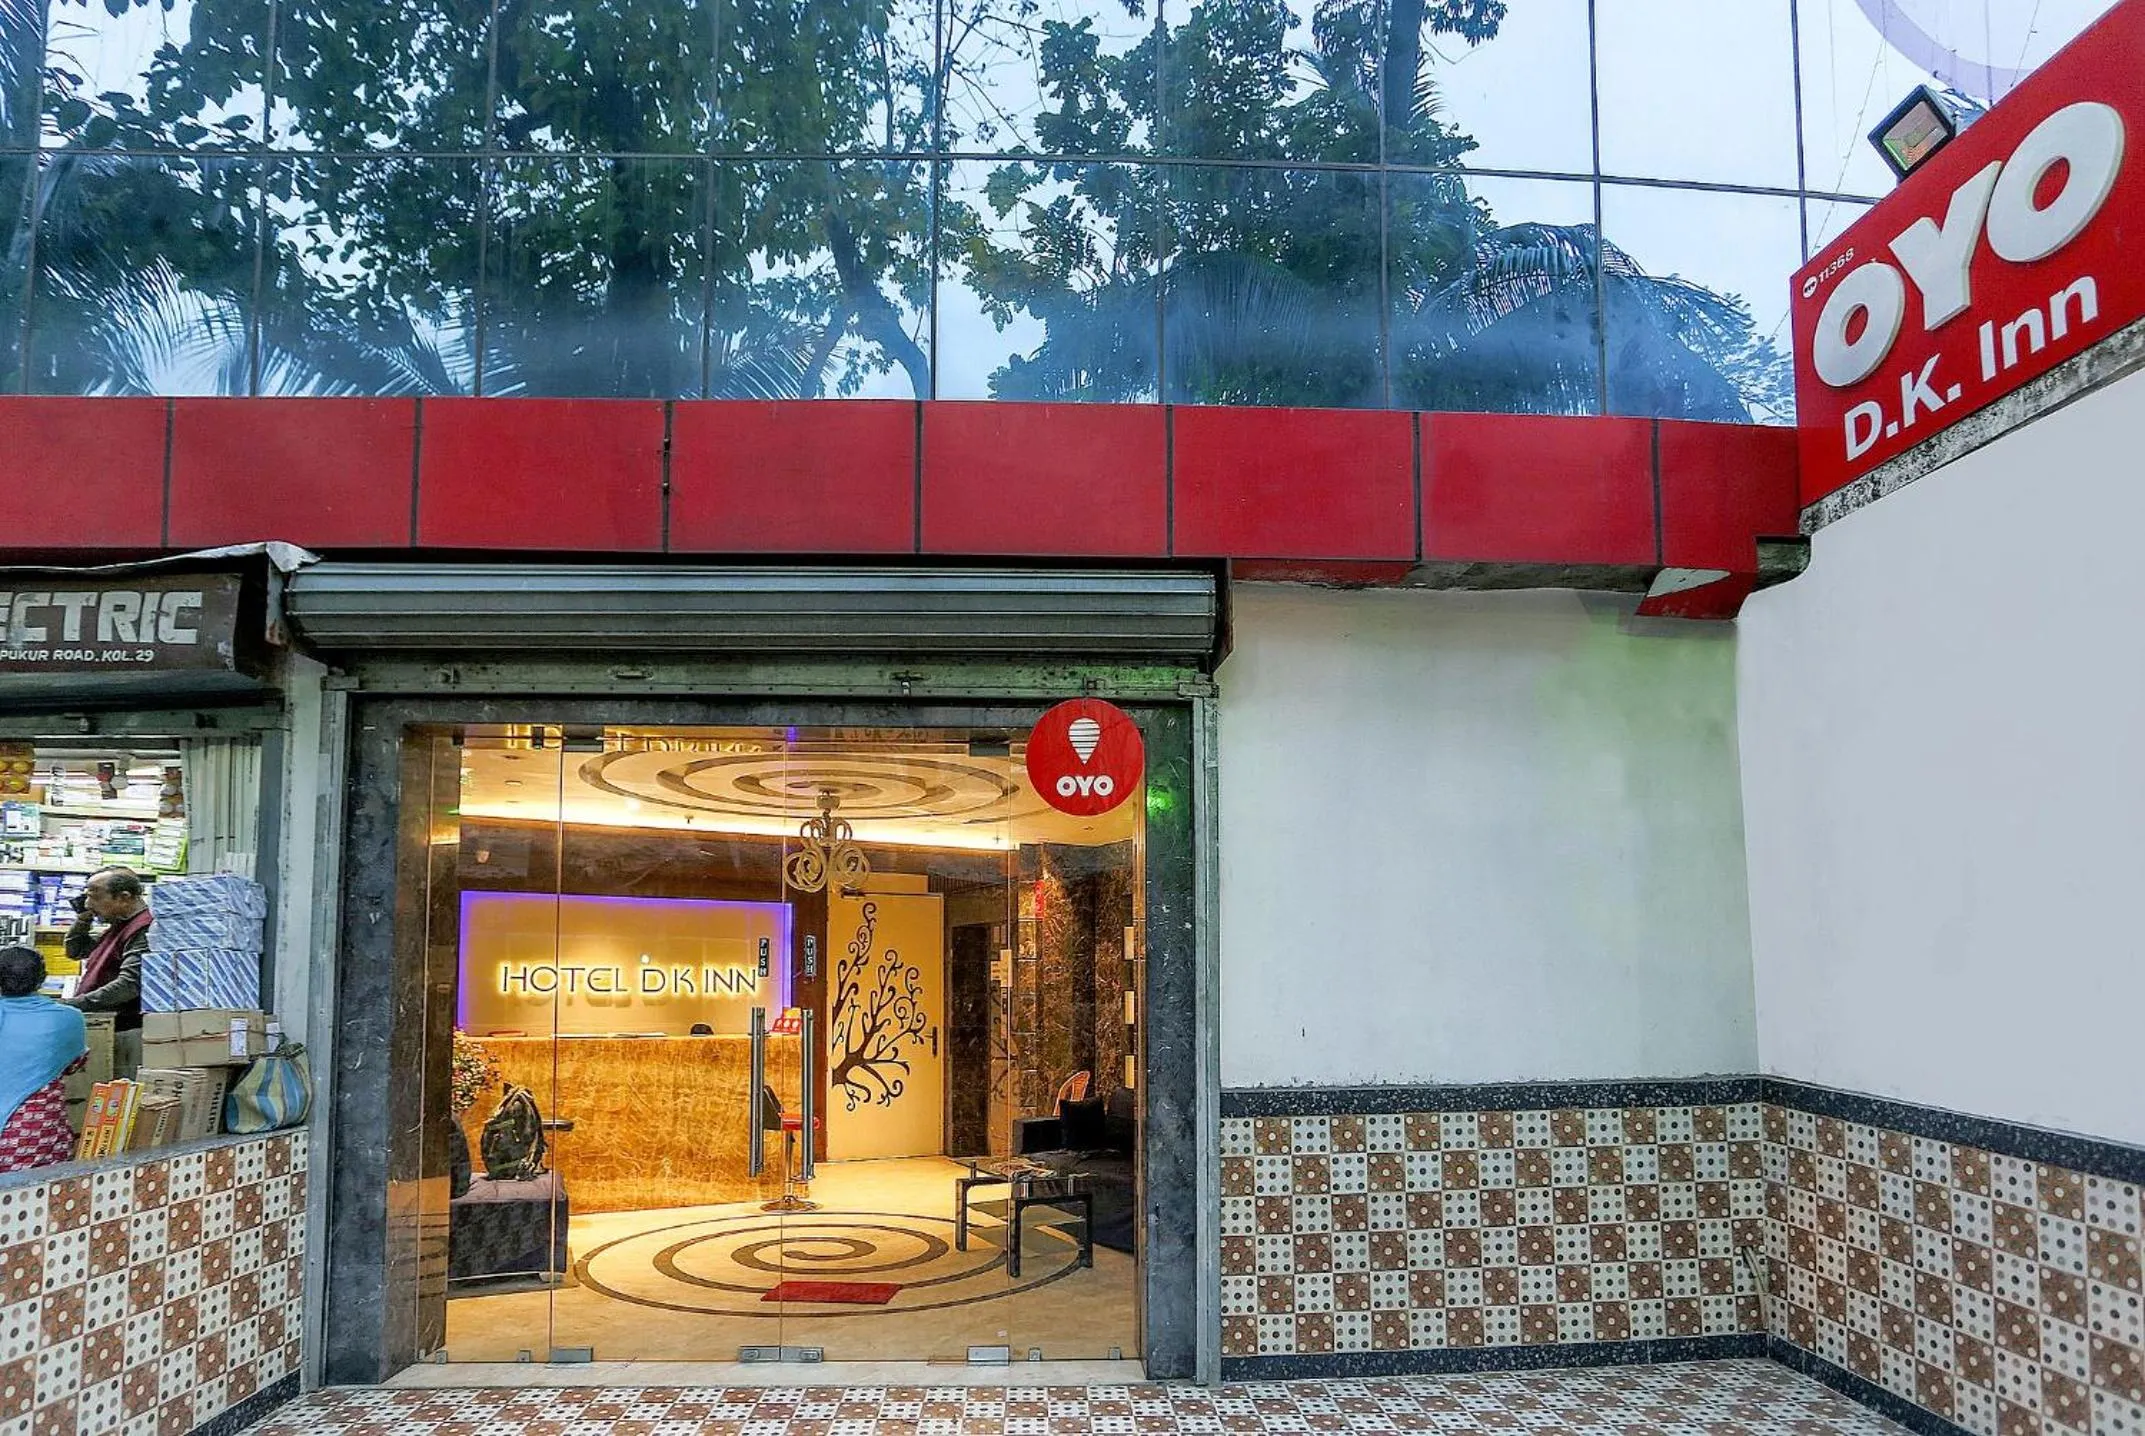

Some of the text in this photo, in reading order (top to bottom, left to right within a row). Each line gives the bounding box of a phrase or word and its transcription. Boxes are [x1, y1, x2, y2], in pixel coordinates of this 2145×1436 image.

[1812, 101, 2126, 388] OYO
[1818, 247, 1855, 283] 11368
[1844, 275, 2098, 461] D.K. Inn
[1056, 774, 1115, 797] OYO
[759, 938, 768, 976] PUSH
[806, 938, 815, 974] PUSH
[502, 966, 628, 993] HOTEL
[704, 968, 757, 994] INN
